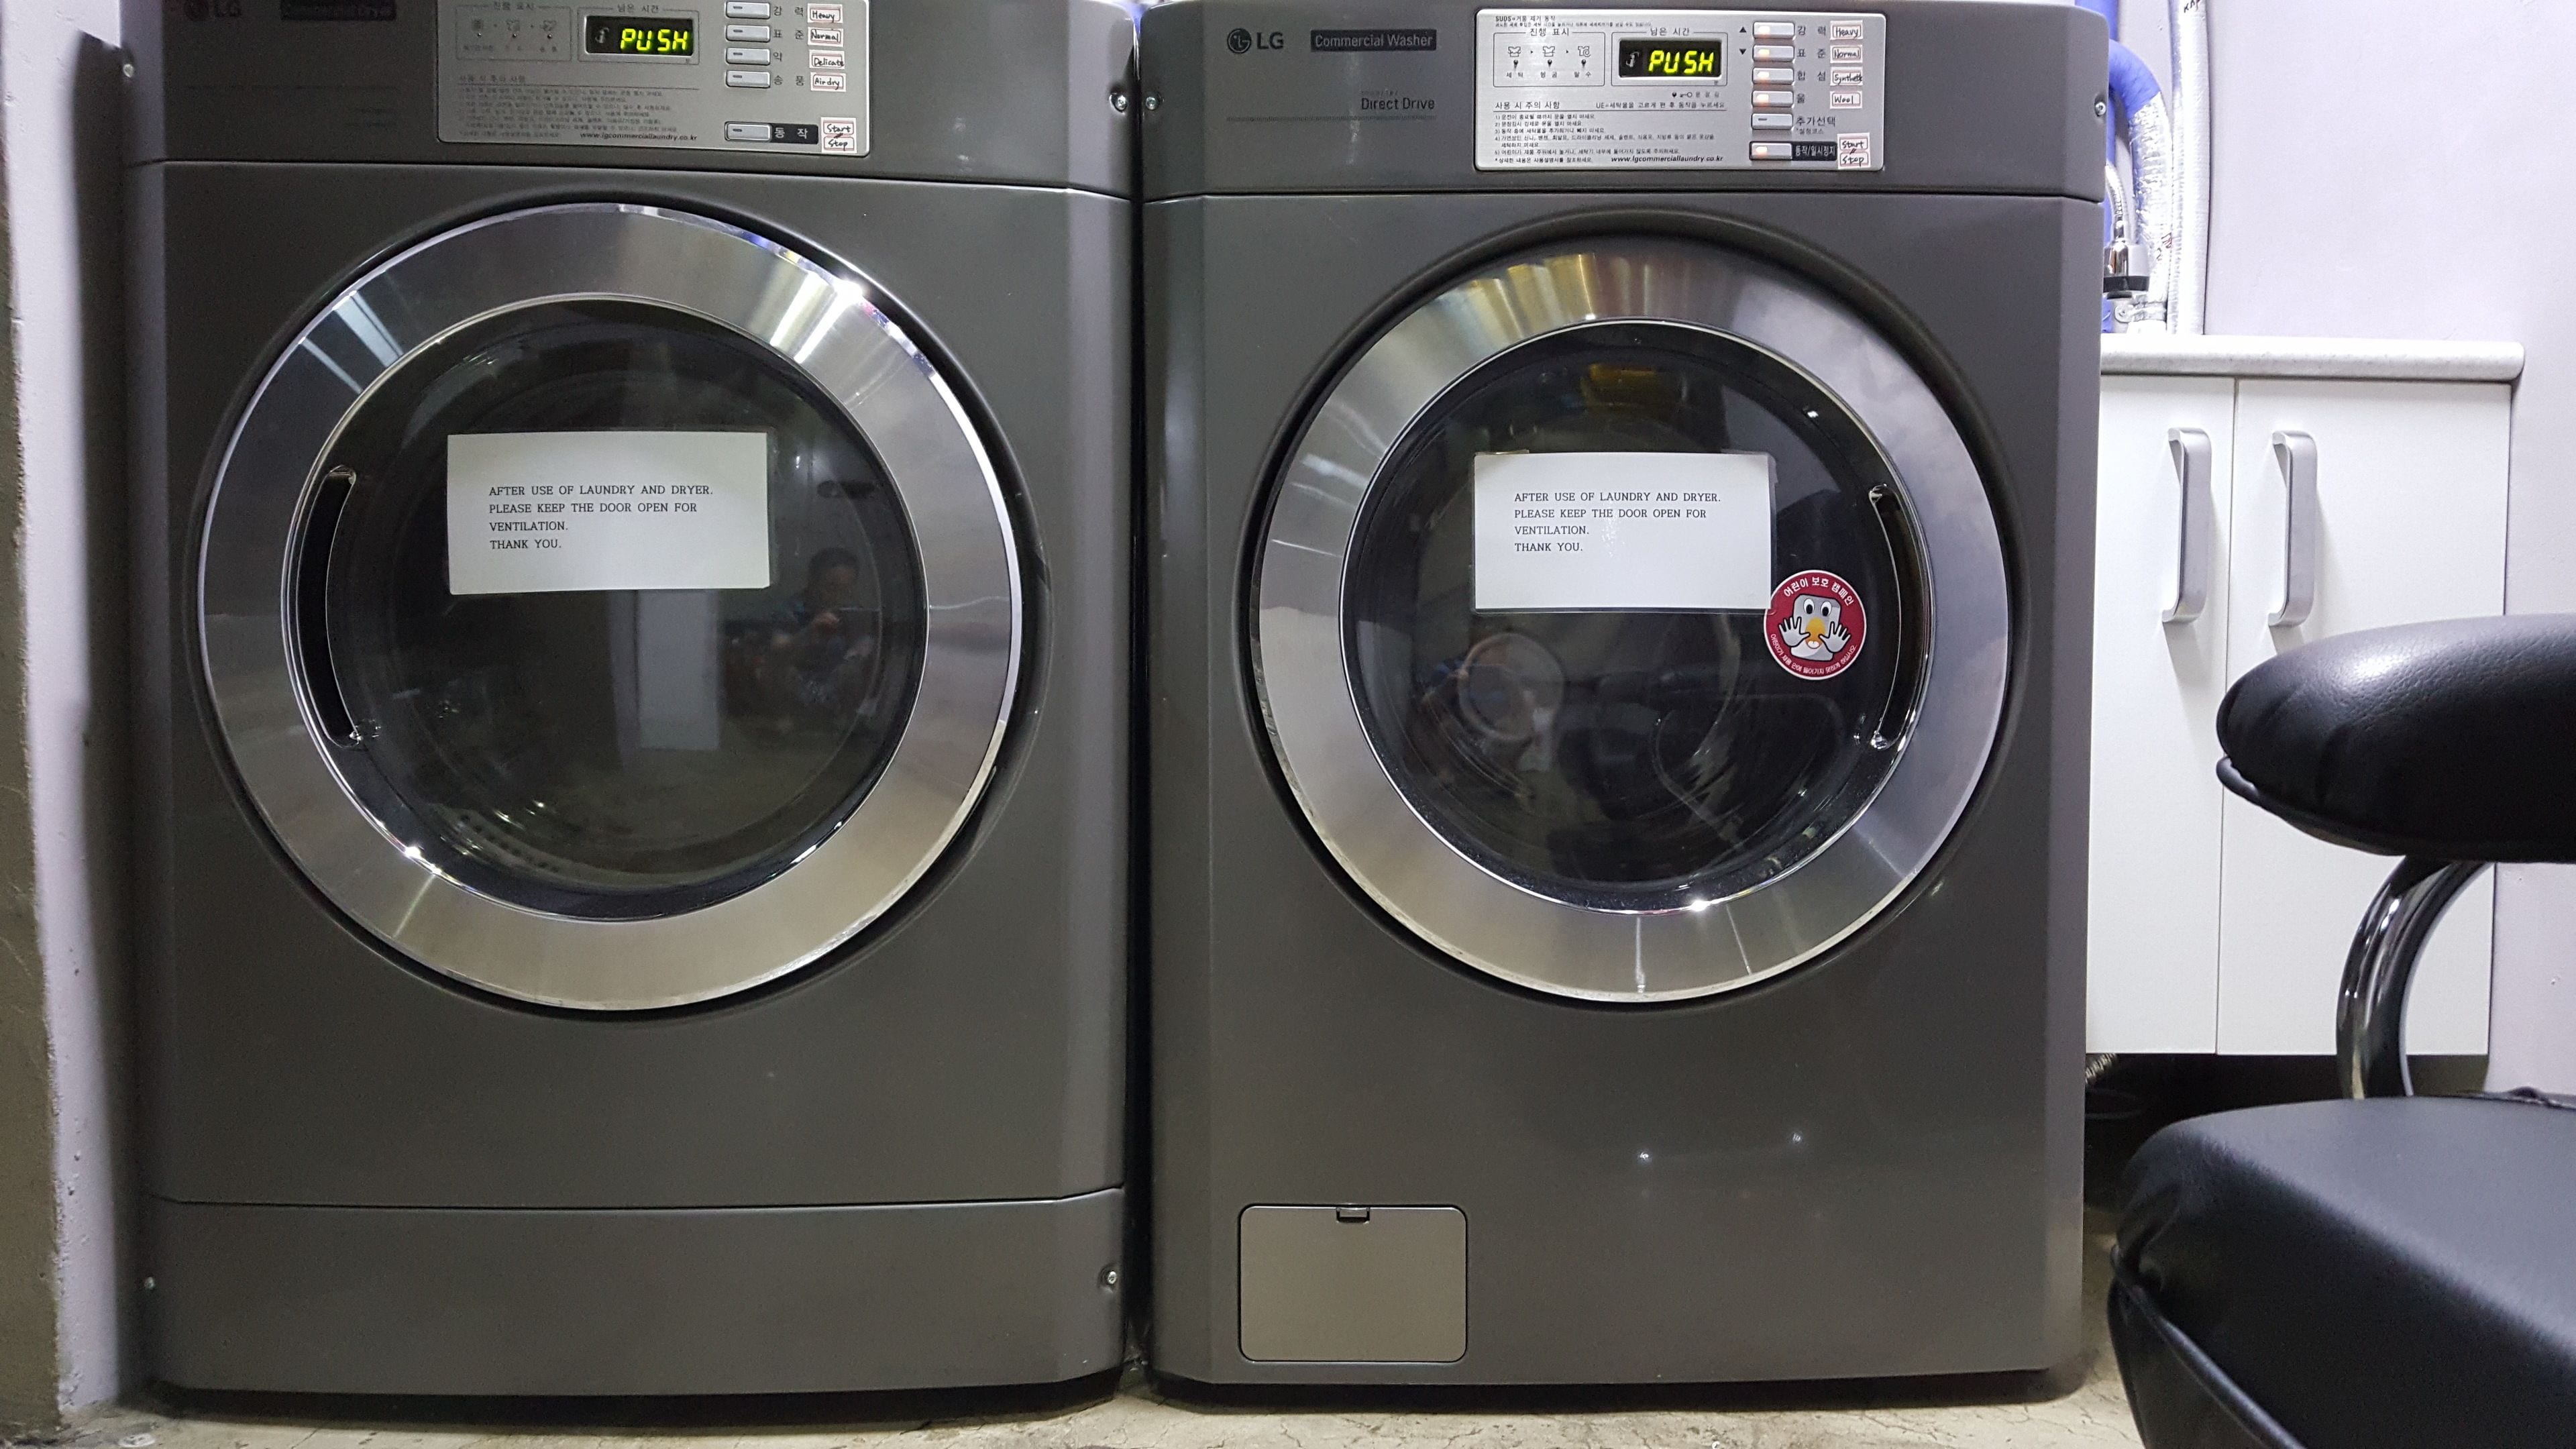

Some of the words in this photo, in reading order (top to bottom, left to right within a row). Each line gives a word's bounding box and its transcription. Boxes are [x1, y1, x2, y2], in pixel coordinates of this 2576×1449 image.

[617, 5, 635, 13] 남은
[641, 5, 659, 14] 시간
[812, 10, 835, 23] Heavy
[811, 30, 839, 43] Normal
[1529, 27, 1548, 37] 진행
[1552, 28, 1570, 37] 표시
[1650, 27, 1667, 36] 남은
[1673, 27, 1690, 36] 시간
[1835, 26, 1859, 38] Heavy
[619, 28, 689, 53] PUSH
[1256, 32, 1284, 49] LG
[1315, 34, 1384, 47] Commercial
[1388, 34, 1434, 46] Washer
[1834, 47, 1860, 58] Normal
[814, 57, 845, 67] Delicate
[1648, 50, 1715, 74] PUSH
[1796, 93, 1805, 103] 울
[1834, 96, 1854, 105] Wool
[1361, 98, 1399, 110] Direct
[1402, 98, 1436, 110] Drive
[1495, 101, 1510, 109] 사용
[1514, 101, 1522, 109] 시
[1525, 101, 1541, 109] 주의
[1544, 101, 1560, 109] 사항
[1796, 115, 1836, 127] 추가선택
[826, 123, 851, 133] Start
[828, 139, 849, 151] Stop
[1841, 140, 1864, 150] Start
[1611, 155, 1724, 164] www.lgcommerciallaundry.co.kr
[1841, 156, 1864, 167] Stop
[489, 486, 525, 496] AFTER
[531, 486, 553, 495] USE
[559, 486, 574, 495] OF
[580, 485, 635, 495] LAUNDRY
[641, 485, 665, 495] AND
[671, 485, 713, 495] DRYER.
[1514, 492, 1549, 502] AFTER
[1554, 492, 1575, 502] USE
[1580, 492, 1595, 502] OF
[1599, 492, 1651, 502] LAUNDRY
[1656, 492, 1678, 502] AND
[1683, 492, 1721, 502] DRYER.
[489, 503, 531, 513] PLEASE
[537, 503, 566, 513] KEEP
[571, 503, 594, 513] THE
[600, 503, 631, 513] DOOR
[637, 502, 669, 513] OPEN
[674, 502, 698, 513] FOR
[1514, 509, 1555, 519] PLEASE
[1560, 509, 1587, 519] KEEP
[1592, 509, 1613, 519] THE
[1618, 509, 1648, 519] DOOR
[1652, 509, 1681, 519] OPEN
[1686, 509, 1707, 519] FOR
[489, 521, 568, 531] VENTILATION.
[1514, 525, 1589, 535] VENTILATION.
[490, 539, 529, 549] THANK
[534, 539, 561, 549] YOU.
[1514, 542, 1552, 552] THANK
[1557, 542, 1583, 552] YOU.
[1783, 578, 1809, 597] 어린이
[1812, 576, 1829, 588] 보호
[1831, 582, 1854, 606] 캠페인
[1770, 634, 1784, 655] 어린이가
